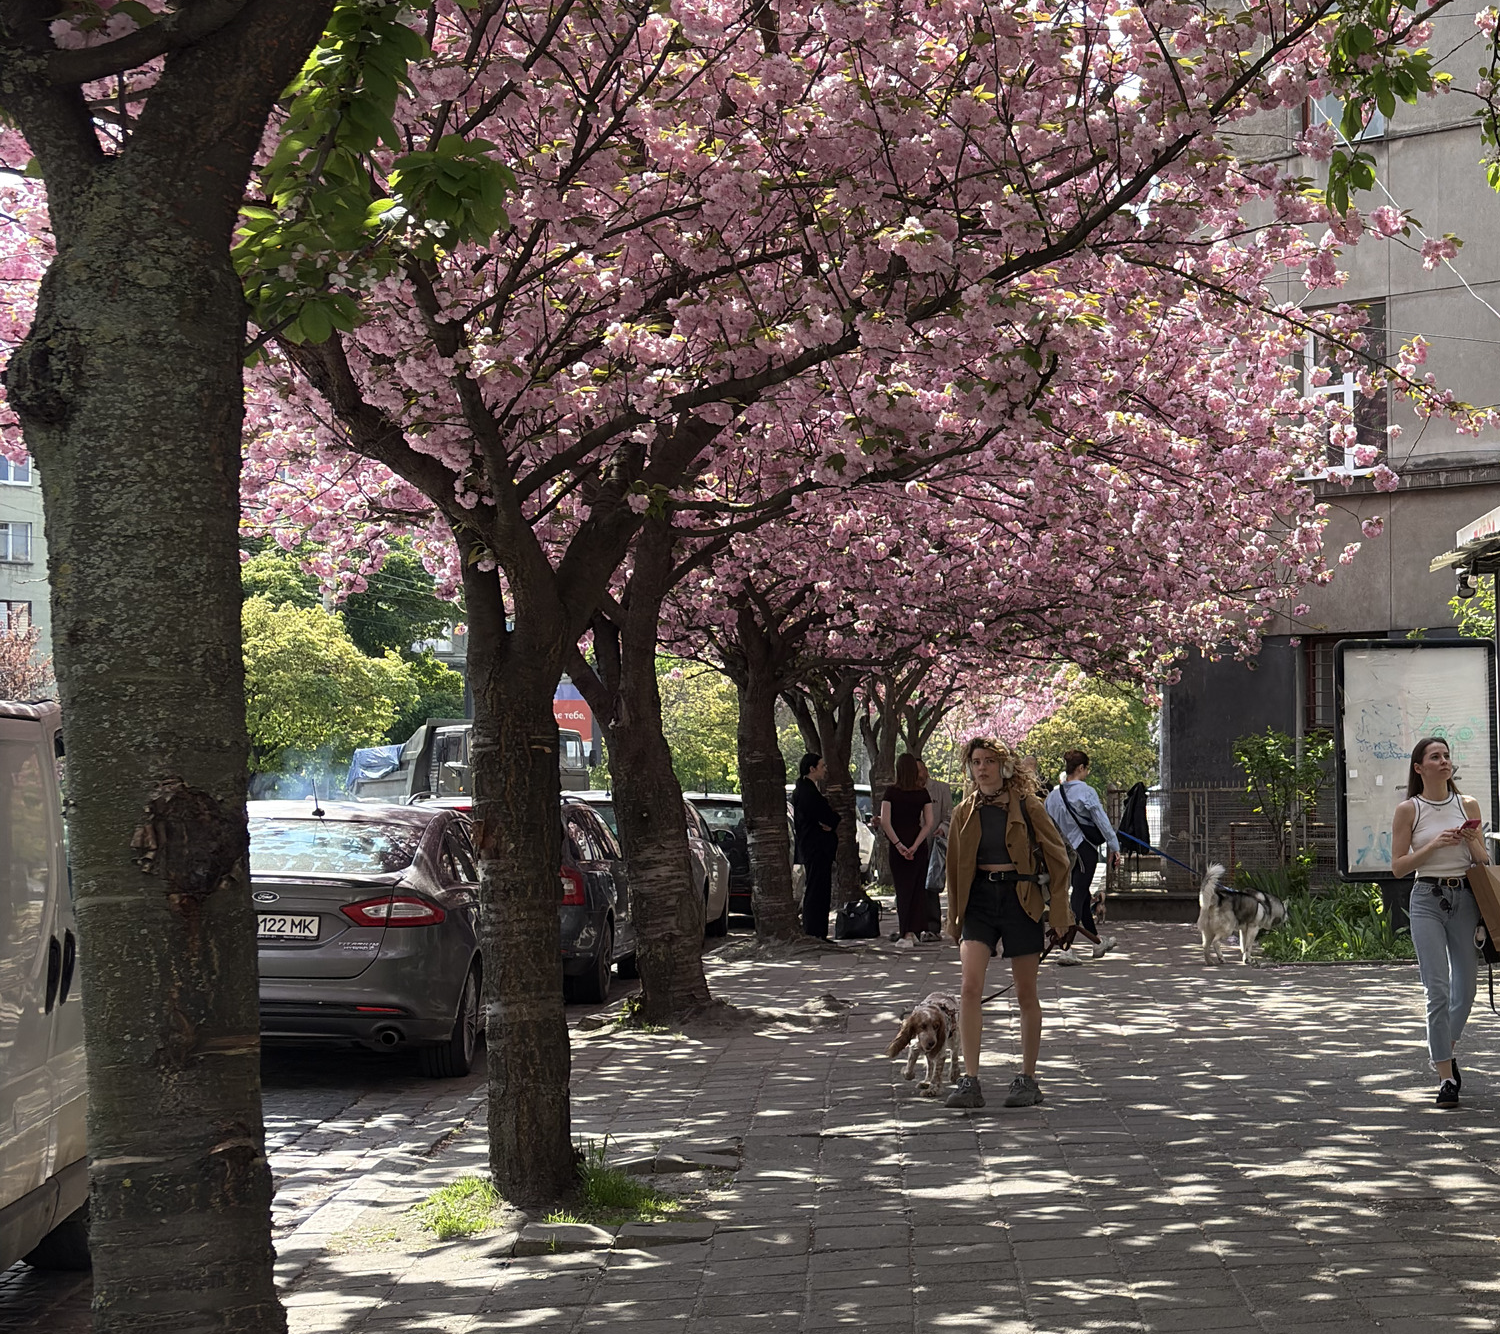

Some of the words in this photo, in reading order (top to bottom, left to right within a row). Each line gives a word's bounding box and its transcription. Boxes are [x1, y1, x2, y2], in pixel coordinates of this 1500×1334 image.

[564, 710, 586, 721] тебе,
[257, 917, 287, 933] 122
[290, 918, 316, 934] MK
